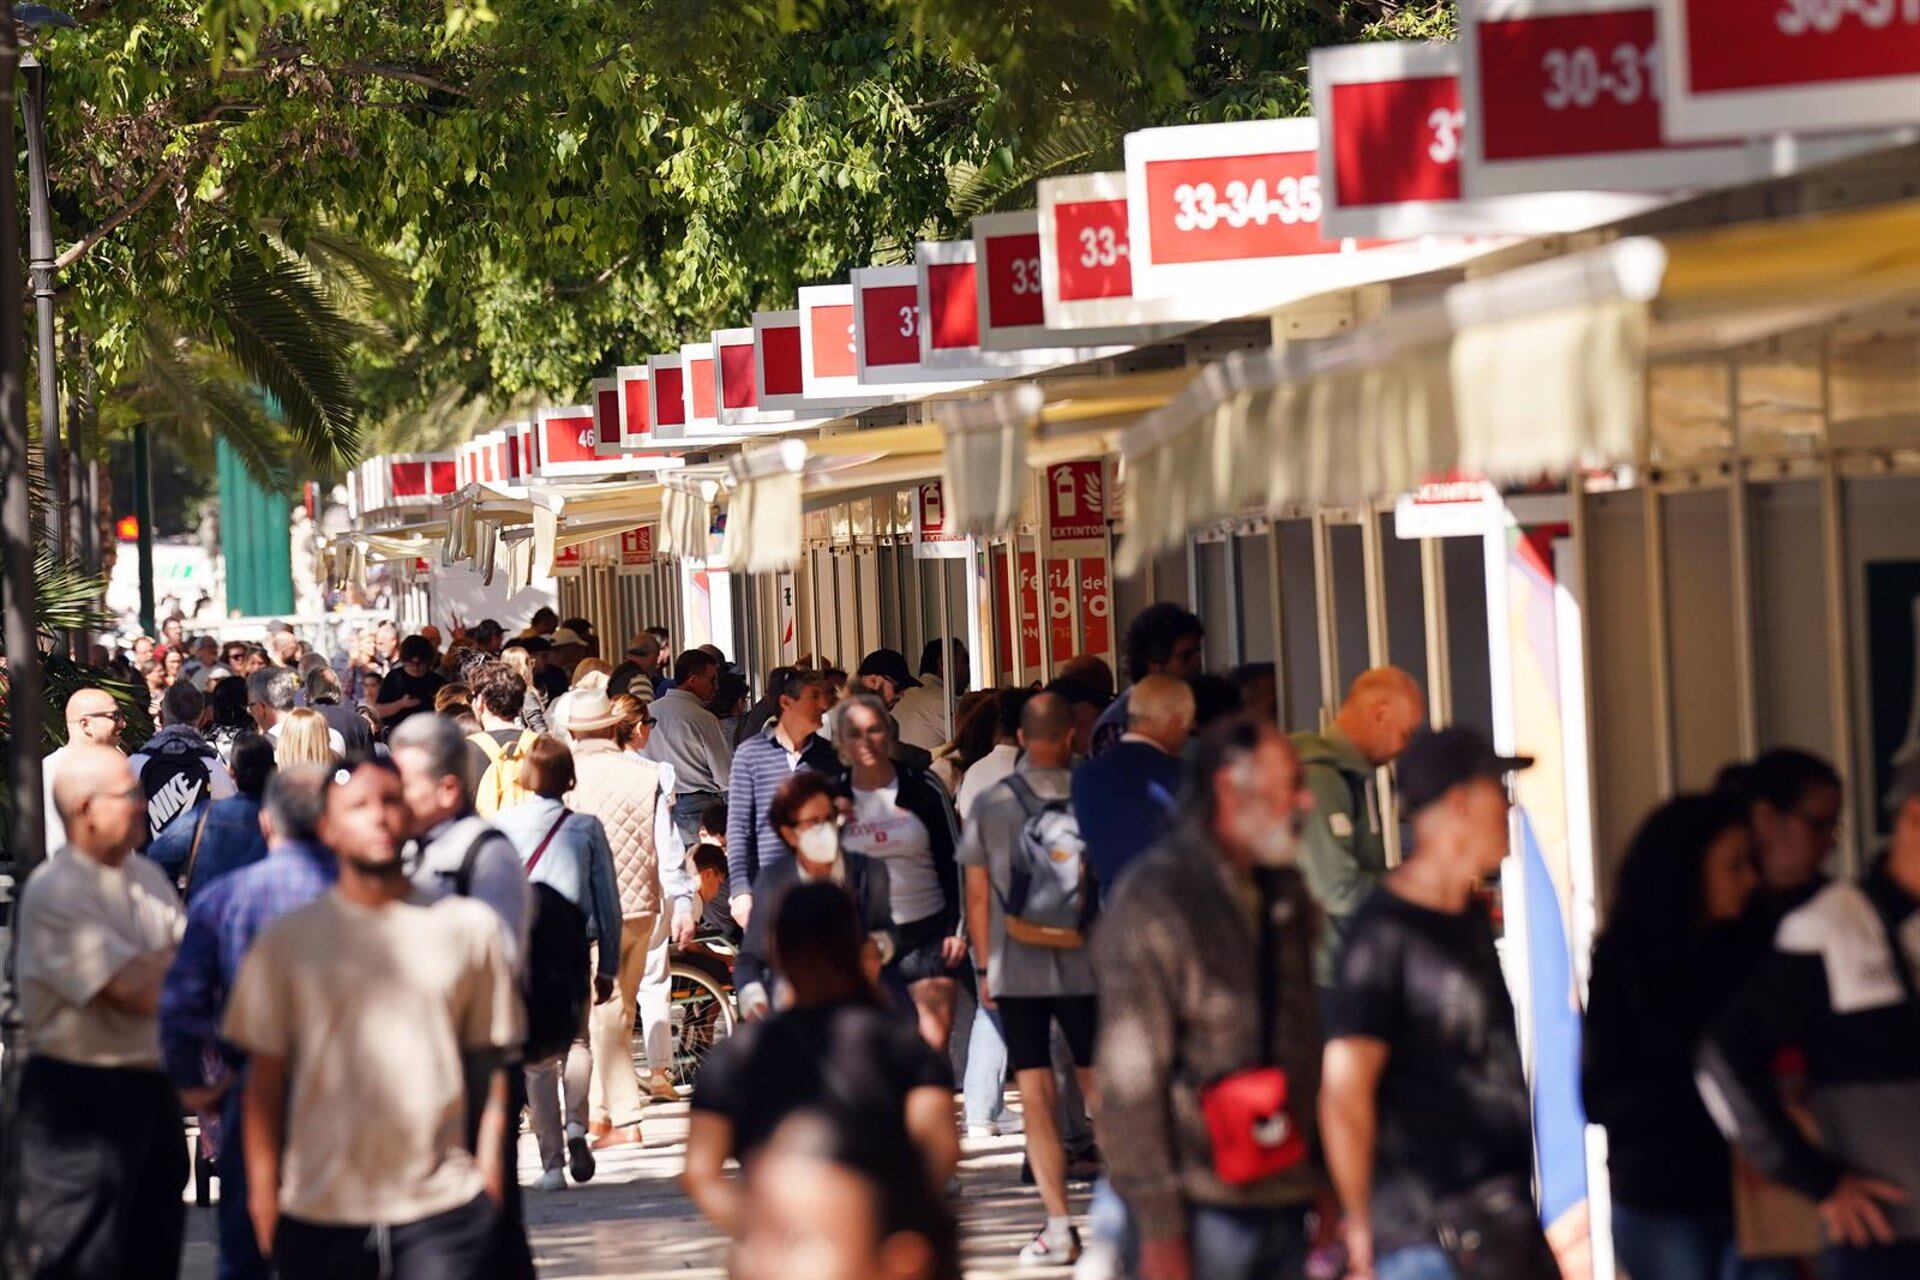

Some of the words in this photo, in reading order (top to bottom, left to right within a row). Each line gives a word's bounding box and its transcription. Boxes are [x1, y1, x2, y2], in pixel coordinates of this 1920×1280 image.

[1174, 175, 1321, 231] 33-34-35
[1079, 225, 1131, 268] 33-
[577, 429, 595, 448] 46
[148, 772, 196, 831] NIKE
